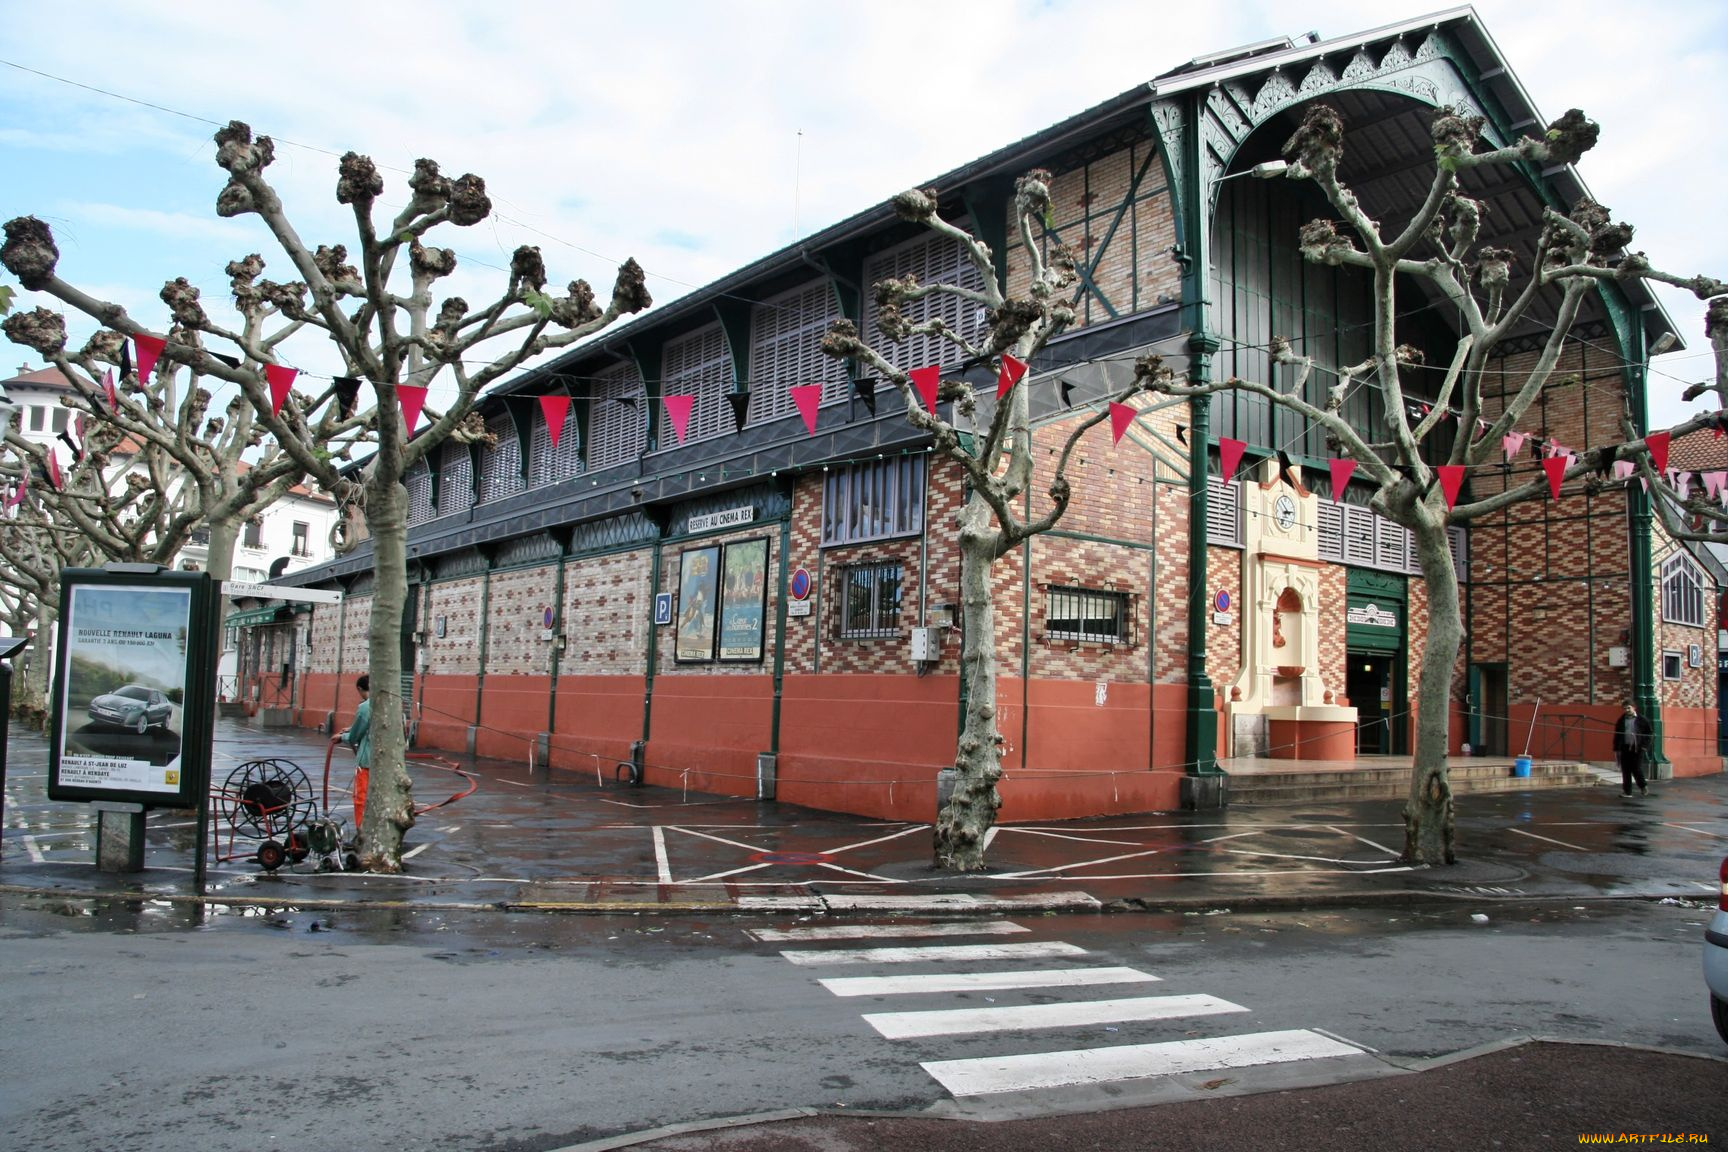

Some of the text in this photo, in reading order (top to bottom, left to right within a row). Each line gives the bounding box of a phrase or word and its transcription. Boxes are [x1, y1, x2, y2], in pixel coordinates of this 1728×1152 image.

[710, 515, 718, 527] AU
[719, 511, 739, 525] CINEMA
[741, 509, 752, 521] REX
[659, 600, 667, 619] P
[752, 617, 758, 630] 2
[78, 629, 111, 637] NOUVELLE
[113, 630, 143, 638] RENAULT
